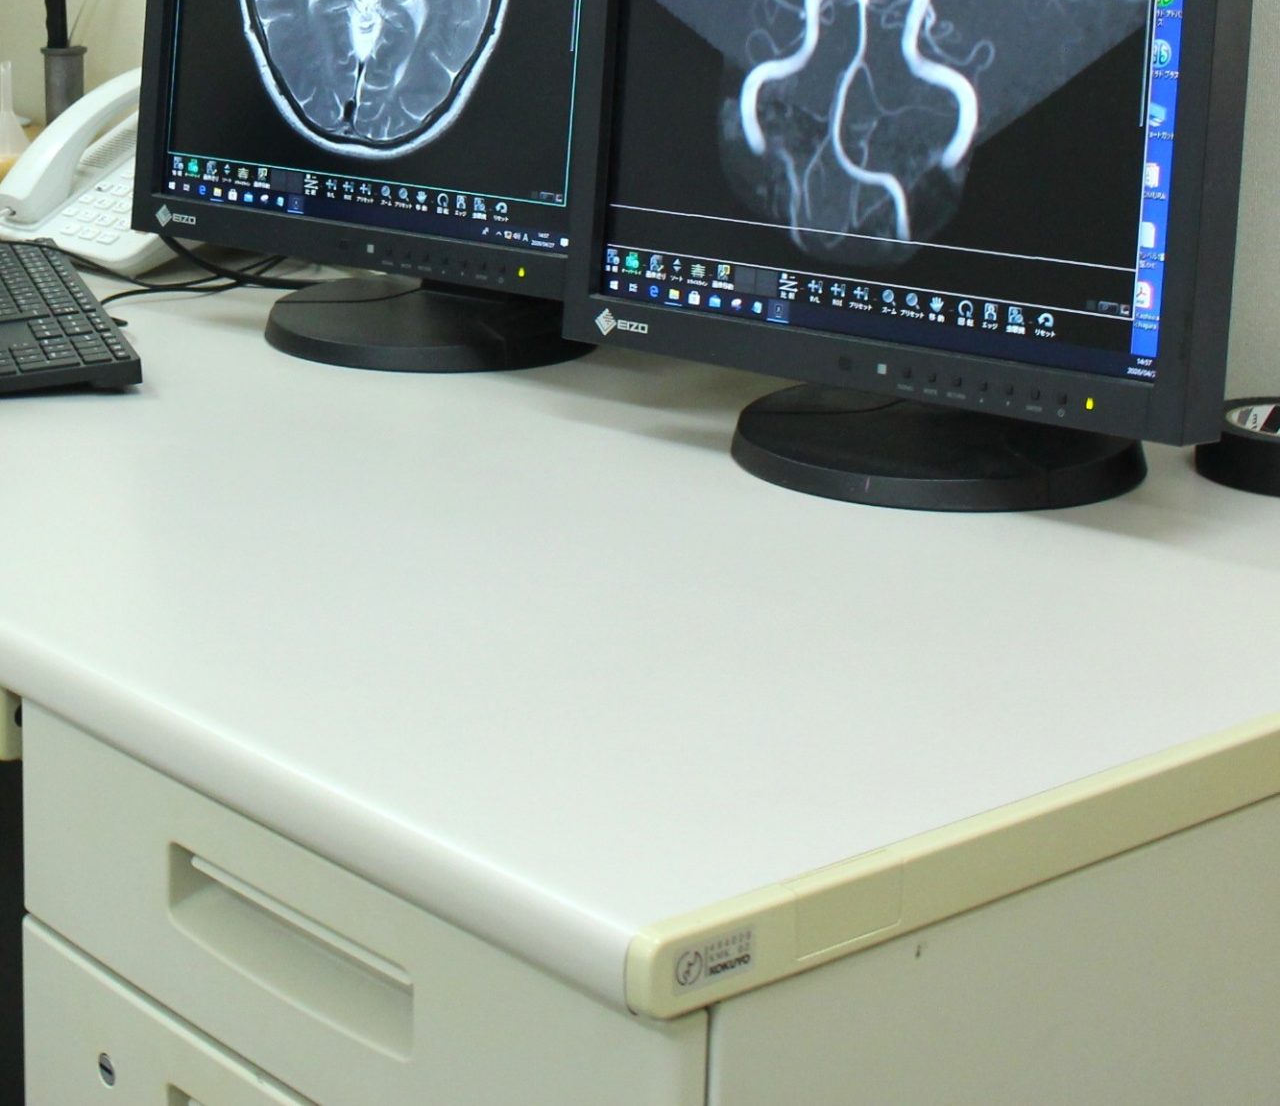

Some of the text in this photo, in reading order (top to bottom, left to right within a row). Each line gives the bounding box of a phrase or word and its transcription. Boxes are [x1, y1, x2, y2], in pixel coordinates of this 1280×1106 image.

[172, 212, 197, 226] EIZO
[617, 319, 649, 334] EIZO
[709, 954, 751, 975] KOKUYO
